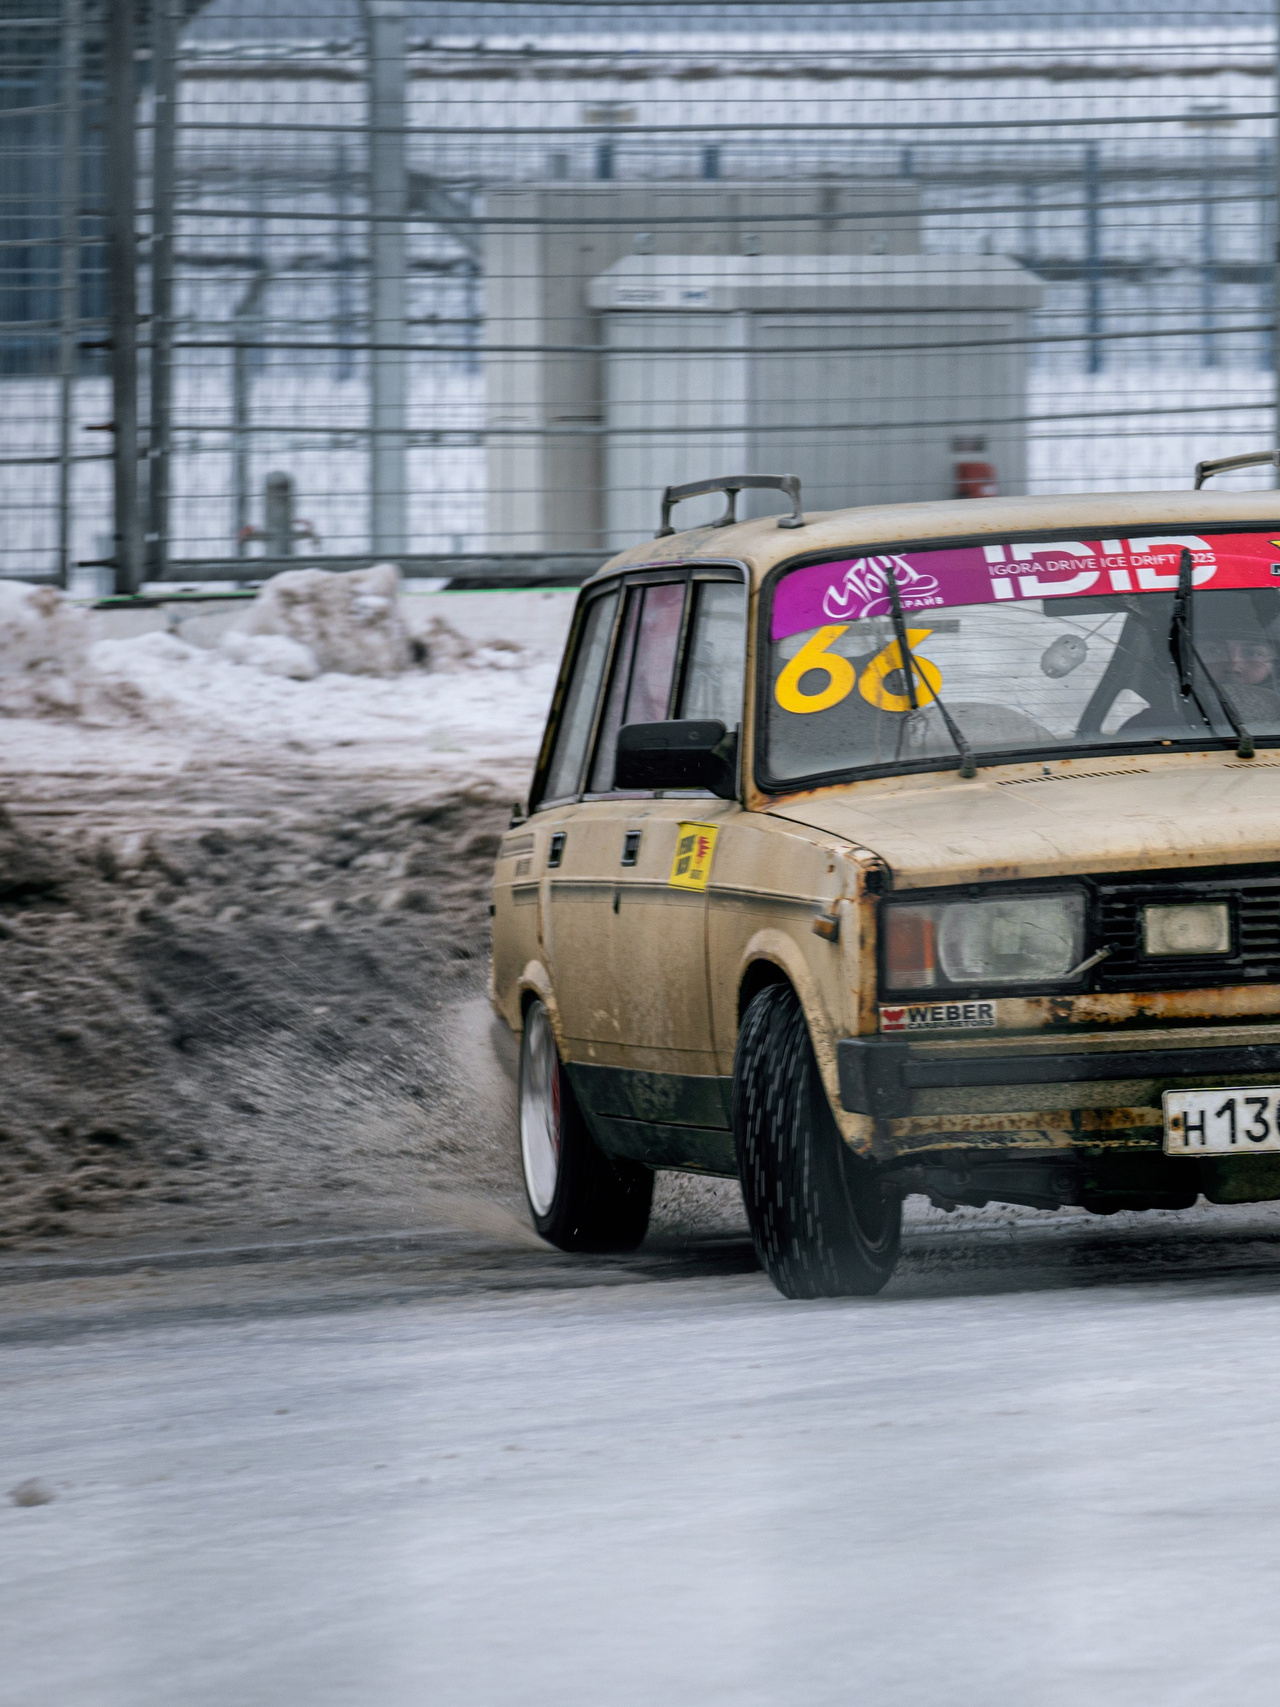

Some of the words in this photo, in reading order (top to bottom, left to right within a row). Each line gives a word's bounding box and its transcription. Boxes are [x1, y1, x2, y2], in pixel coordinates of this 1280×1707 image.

[988, 560, 1044, 576] IGORA
[1046, 558, 1098, 572] DRIVE
[1100, 556, 1129, 567] ICE
[1131, 553, 1177, 566] DRIFT
[774, 625, 943, 714] 66
[908, 1003, 995, 1022] WEBER
